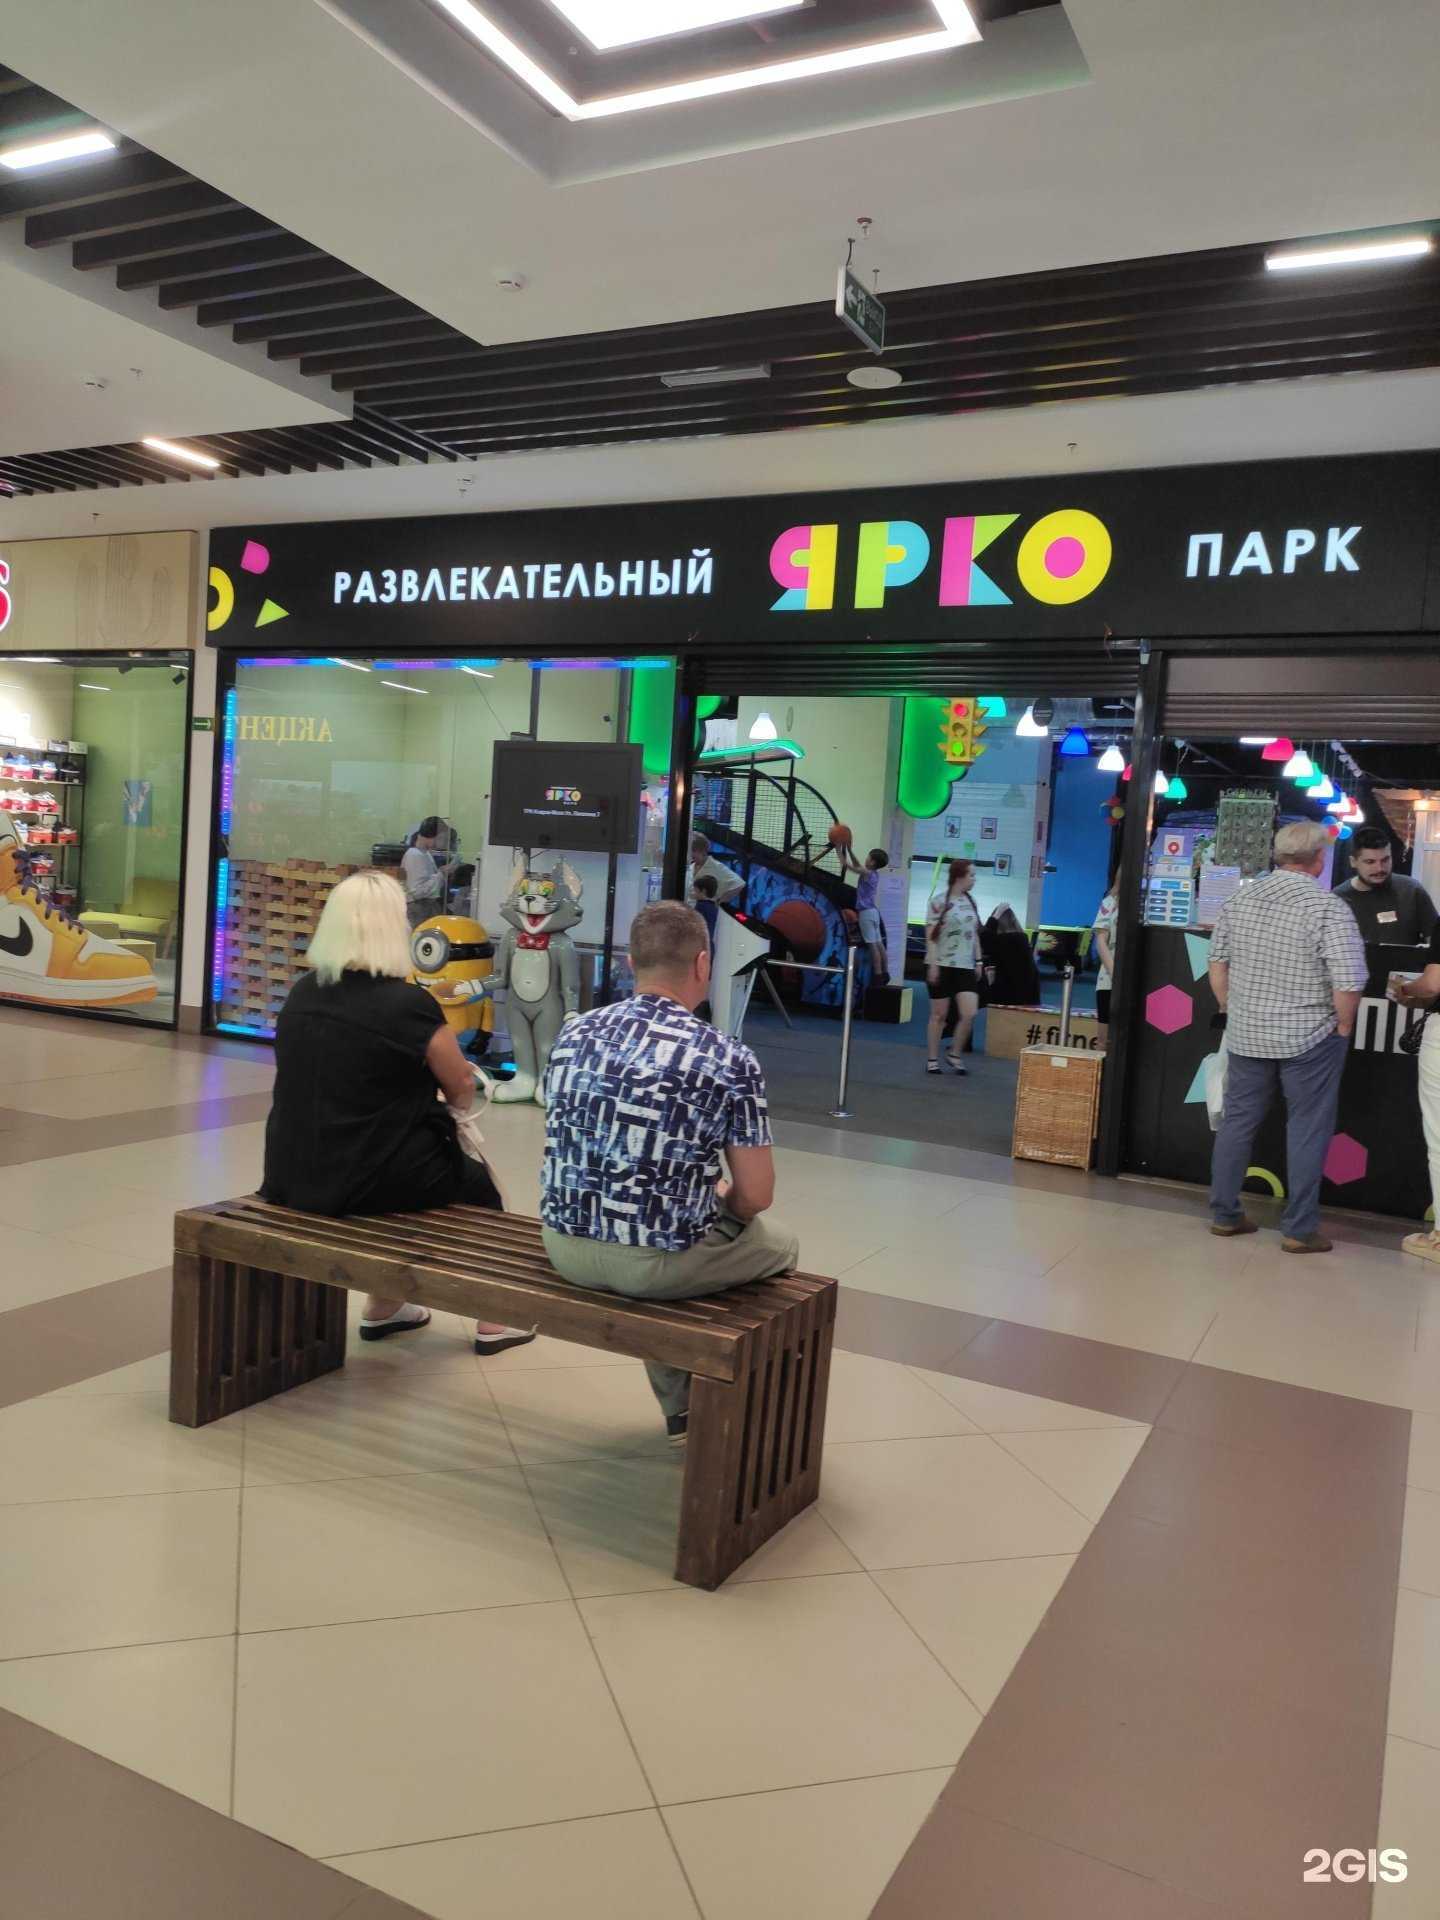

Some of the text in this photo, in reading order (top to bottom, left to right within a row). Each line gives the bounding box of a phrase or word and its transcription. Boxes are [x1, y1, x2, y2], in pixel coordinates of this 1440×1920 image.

[333, 508, 1363, 611] РАЗВЛЕКАТЕЛЬНЫЙ ЯРКО ПАРК
